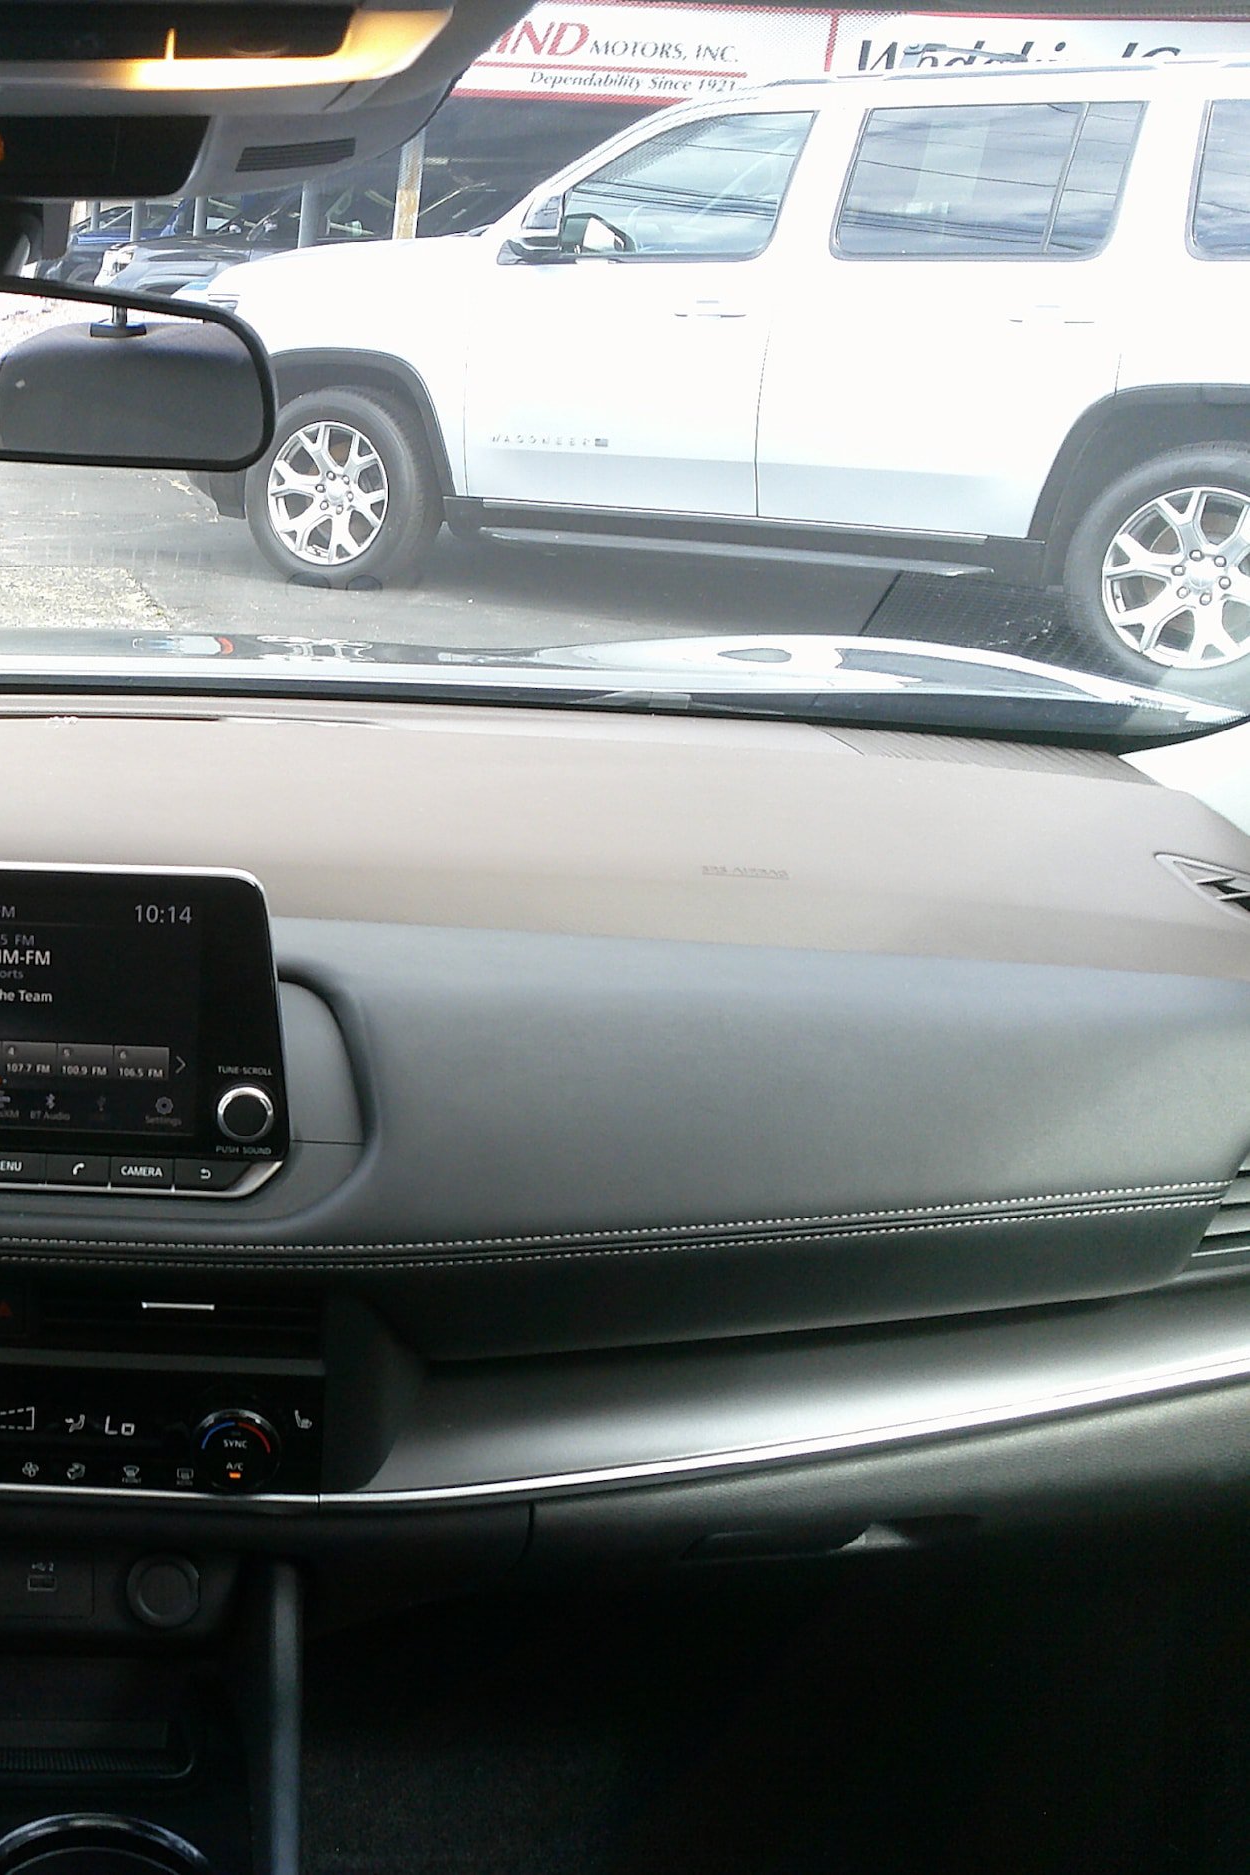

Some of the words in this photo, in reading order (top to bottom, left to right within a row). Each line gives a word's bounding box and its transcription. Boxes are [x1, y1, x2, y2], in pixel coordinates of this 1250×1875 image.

[695, 44, 739, 63] INC.
[530, 71, 642, 91] Dependability
[648, 75, 692, 91] Since
[134, 904, 193, 924] 10:14
[14, 933, 35, 947] FM
[18, 989, 53, 1003] Team
[36, 1064, 51, 1073] FM
[92, 1066, 107, 1076] FM
[148, 1068, 163, 1078] FM
[120, 1165, 163, 1178] CAMERA
[105, 1415, 135, 1437] Lo
[223, 1439, 248, 1450] SYNC
[226, 1462, 244, 1472] A/C
